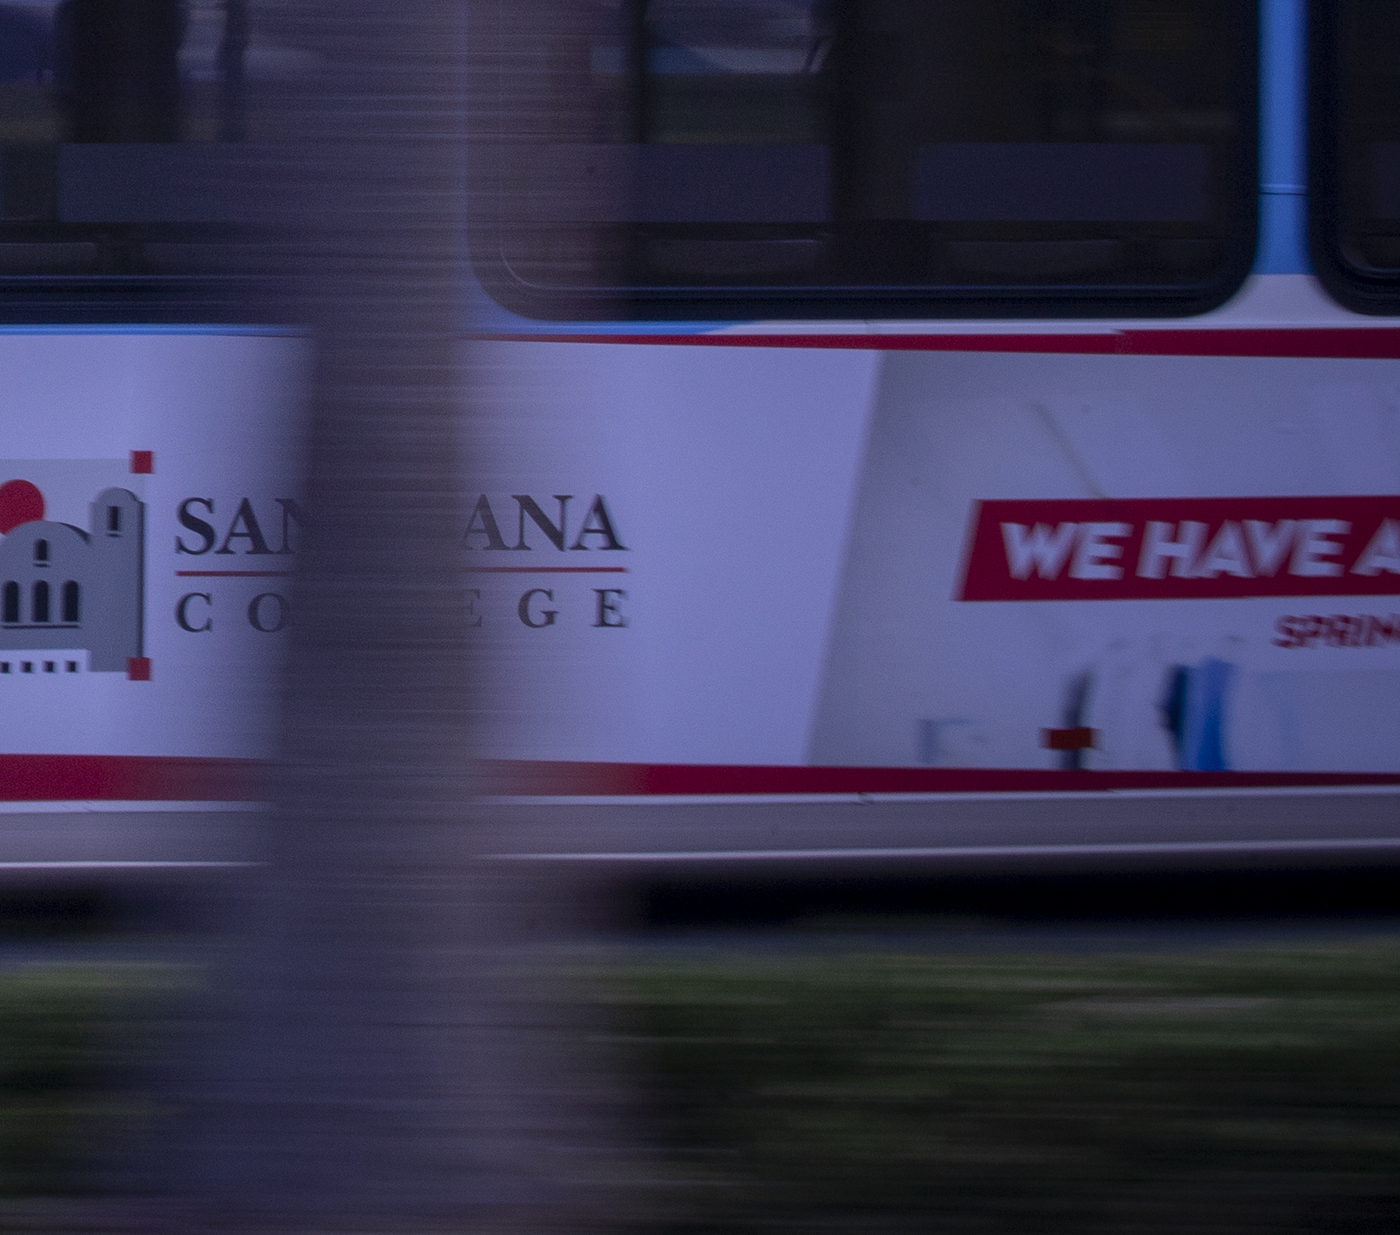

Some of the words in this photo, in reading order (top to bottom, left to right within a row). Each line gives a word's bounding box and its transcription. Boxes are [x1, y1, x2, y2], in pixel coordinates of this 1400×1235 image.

[175, 496, 314, 555] SAN
[462, 493, 632, 552] ANA
[999, 520, 1134, 581] WE
[1135, 518, 1353, 580] HAVE
